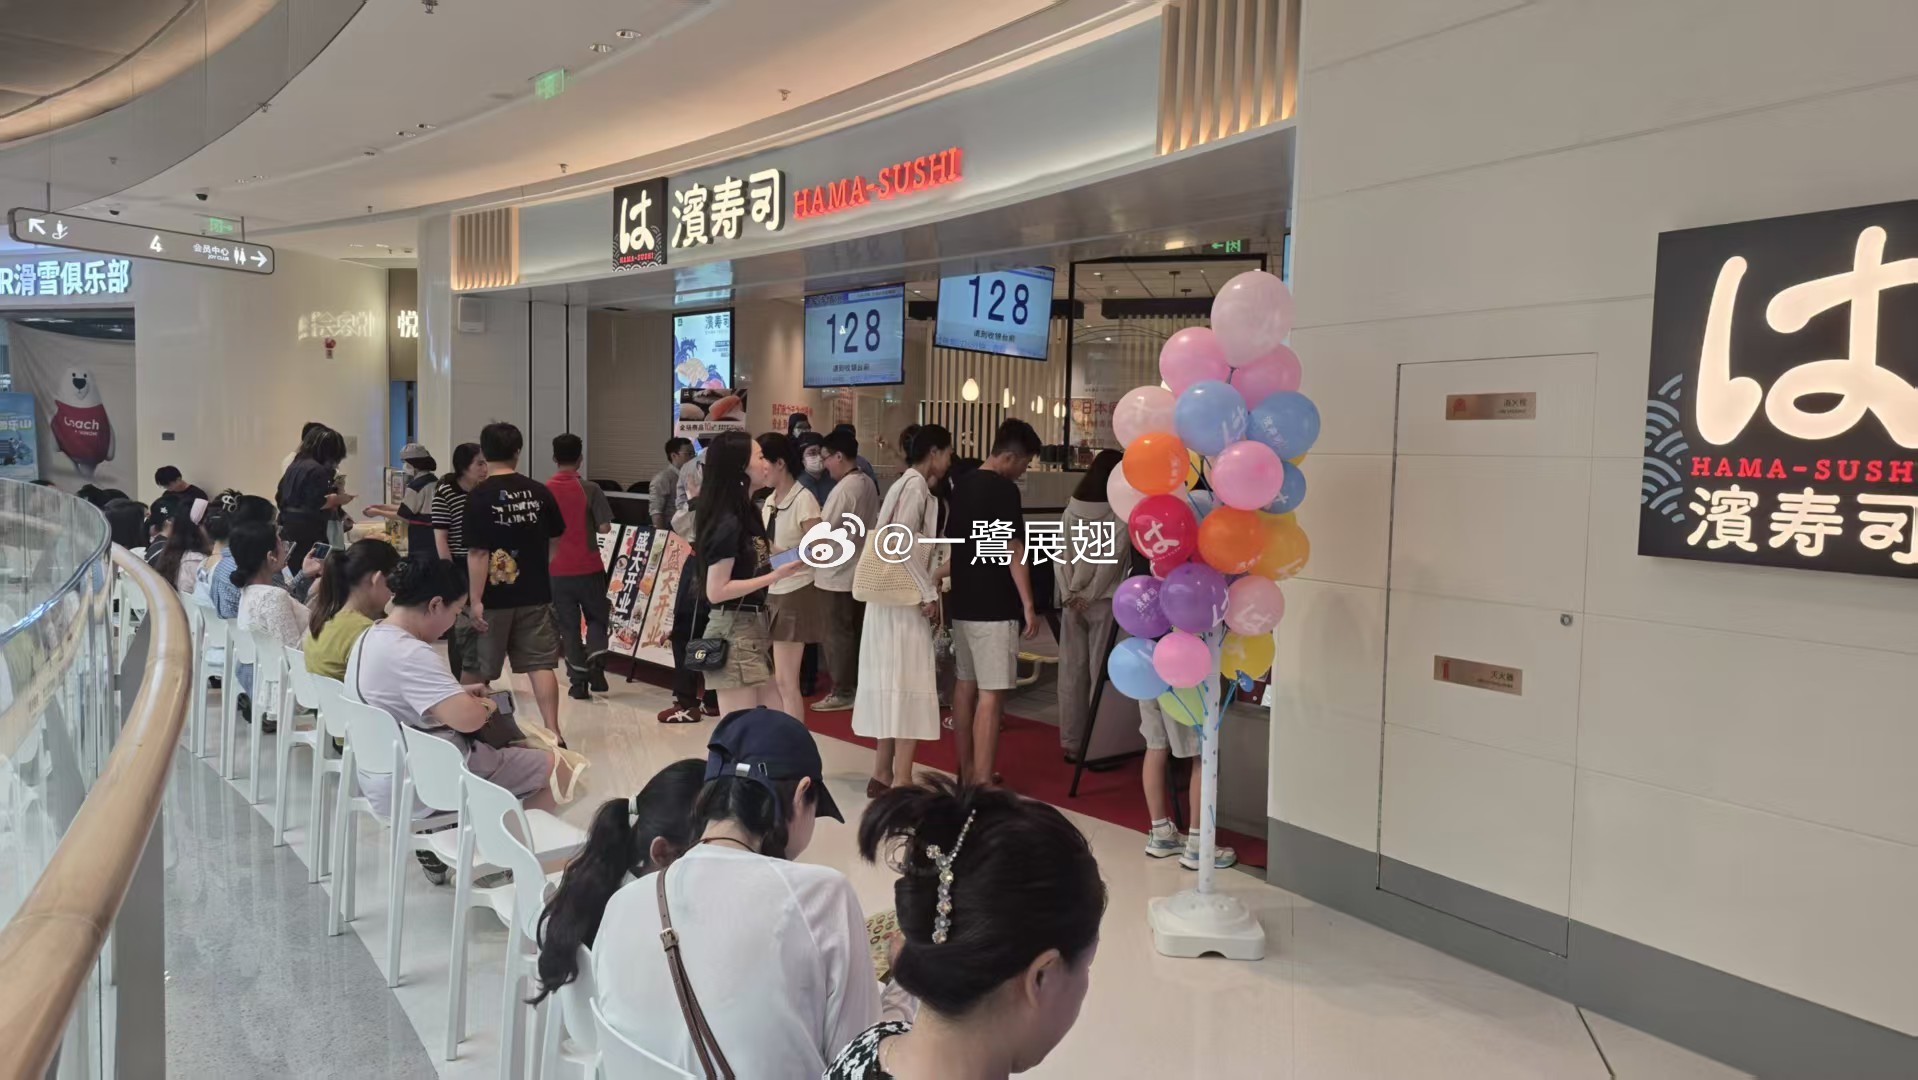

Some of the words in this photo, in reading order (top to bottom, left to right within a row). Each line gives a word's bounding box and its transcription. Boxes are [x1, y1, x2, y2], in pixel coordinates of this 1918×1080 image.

[672, 168, 787, 249] 濱寿司
[792, 147, 964, 219] HAMA-SUSHI
[150, 235, 163, 253] 4
[192, 243, 230, 256] 会员中心
[619, 189, 656, 254] は
[826, 309, 881, 355] 128
[968, 276, 1029, 326] 128
[1695, 225, 1918, 449] は
[1134, 520, 1180, 558] は
[1686, 484, 1918, 564] 濱寿司
[615, 531, 649, 614] 盛大开业
